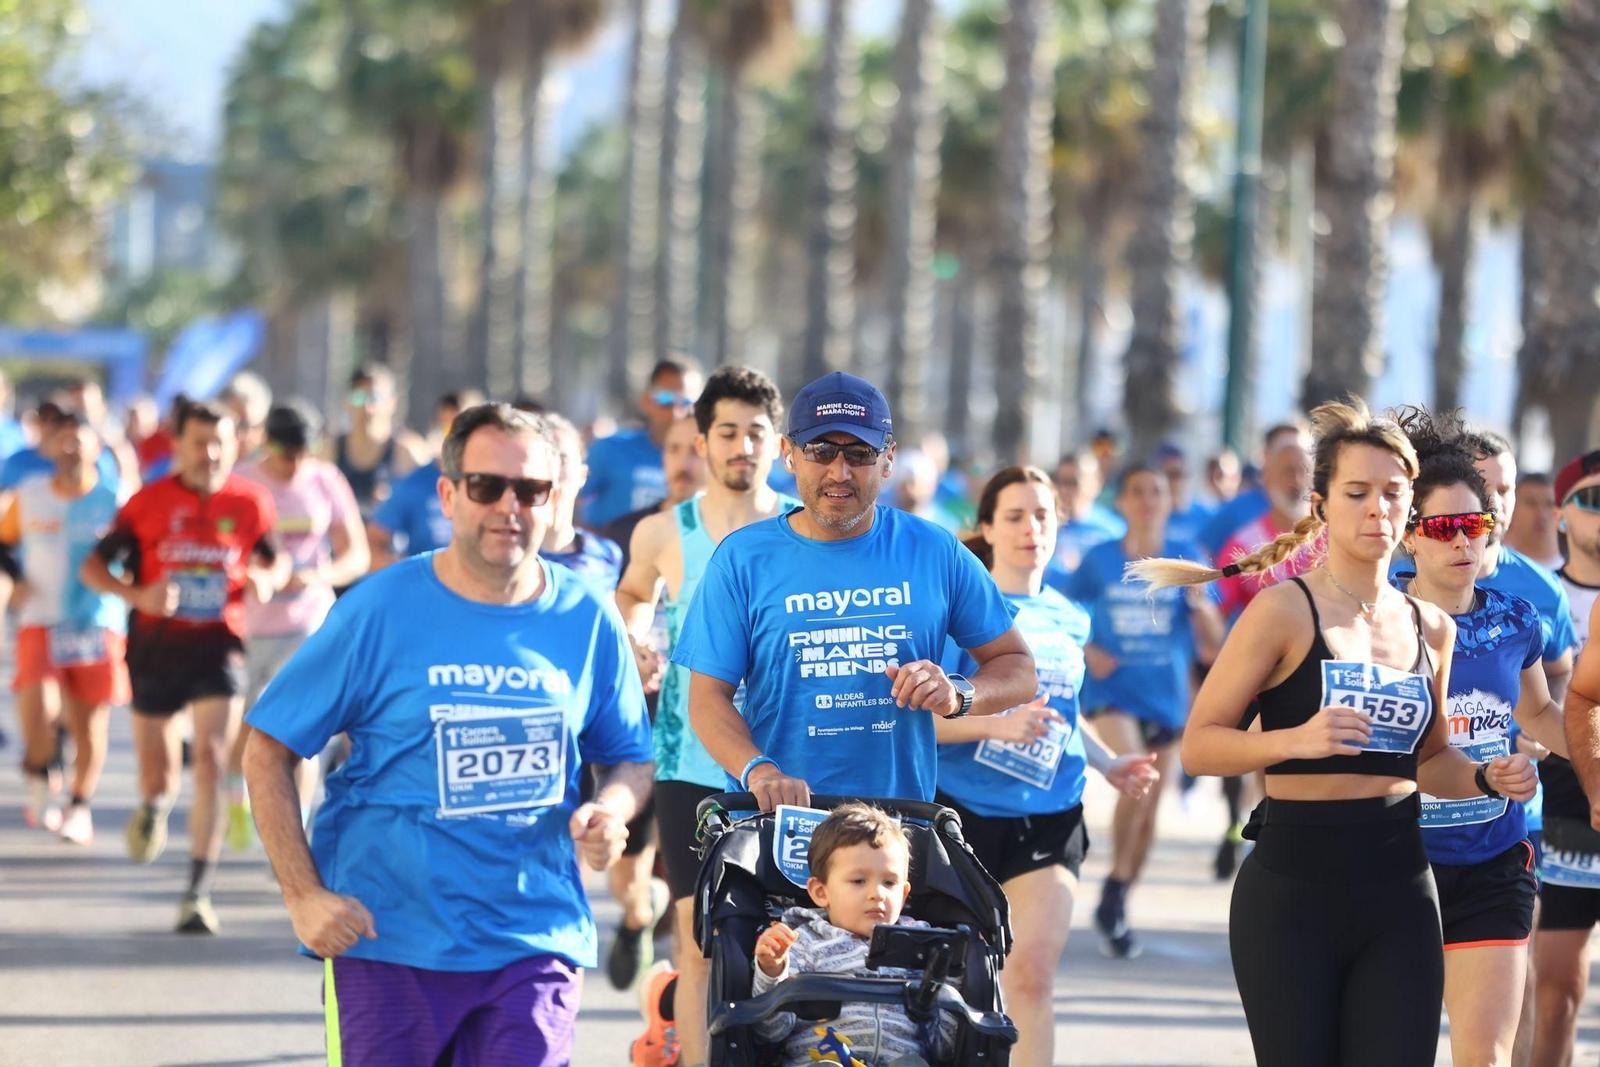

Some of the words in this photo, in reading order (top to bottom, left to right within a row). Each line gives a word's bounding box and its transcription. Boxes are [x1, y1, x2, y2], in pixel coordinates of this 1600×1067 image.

[817, 403, 842, 411] MARINE
[843, 403, 866, 412] CORPS
[822, 408, 860, 416] MARATHON
[785, 581, 912, 616] mayoral
[789, 625, 907, 647] RUNNING
[801, 642, 898, 662] MAKES
[800, 658, 900, 678] FRIENDS
[428, 663, 571, 696] mayoral
[835, 692, 864, 701] ALDEAS
[835, 698, 877, 709] INFANTILES
[878, 697, 893, 705] SOS
[1448, 701, 1486, 717] AGA
[457, 746, 551, 779] 2073
[1420, 803, 1442, 811] 10KM
[798, 817, 822, 828] Carr
[782, 861, 804, 871] 10KM
